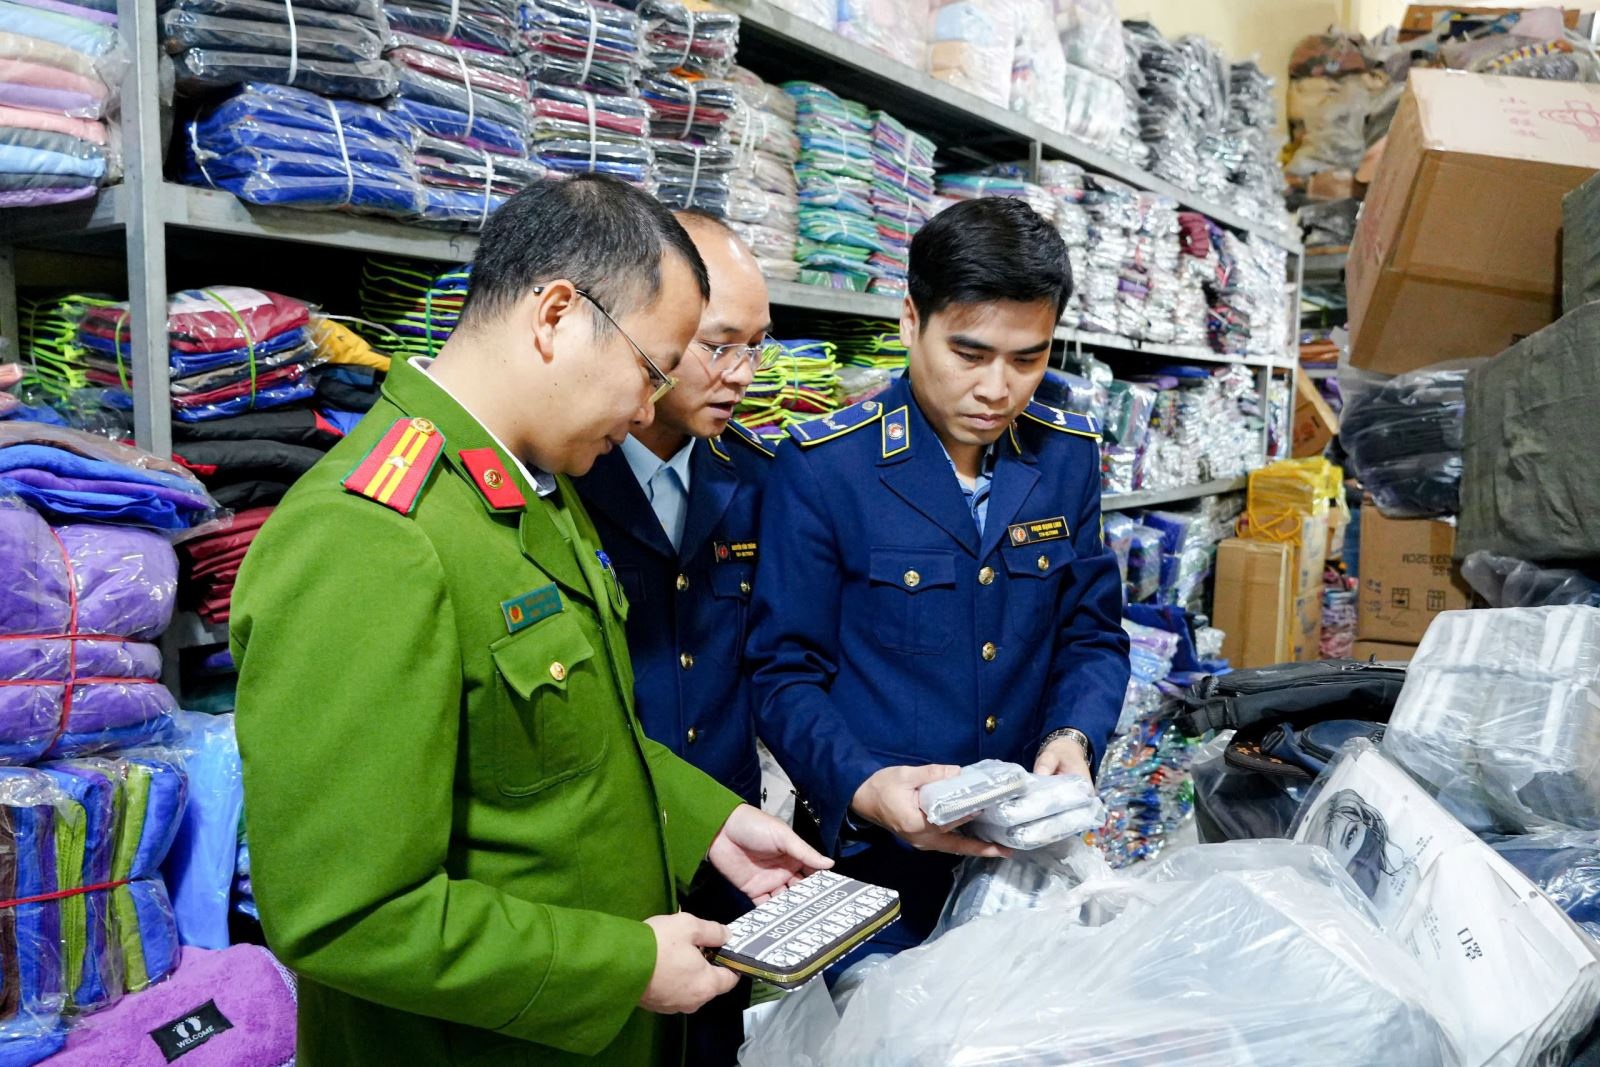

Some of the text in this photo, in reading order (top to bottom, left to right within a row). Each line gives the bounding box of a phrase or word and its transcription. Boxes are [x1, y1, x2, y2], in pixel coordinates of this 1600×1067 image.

[766, 890, 848, 939] CHRISTIAN DIOR
[1457, 927, 1483, 961] 口罩
[176, 1025, 215, 1048] WELCOME
